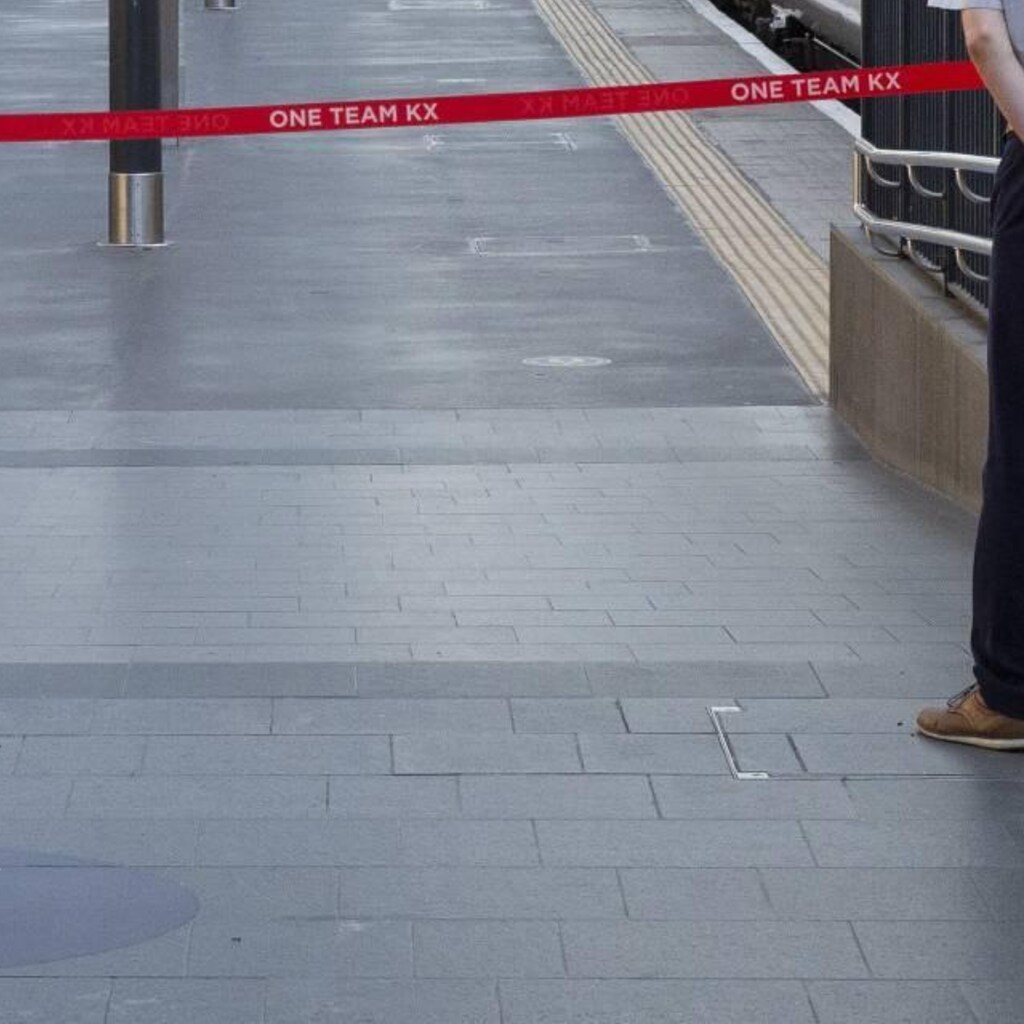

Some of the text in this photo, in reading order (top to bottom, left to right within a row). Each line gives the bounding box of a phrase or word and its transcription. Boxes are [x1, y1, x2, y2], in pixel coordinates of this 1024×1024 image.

[731, 71, 902, 102] ONE TEAM KX
[270, 103, 439, 129] ONE TEAM KX
